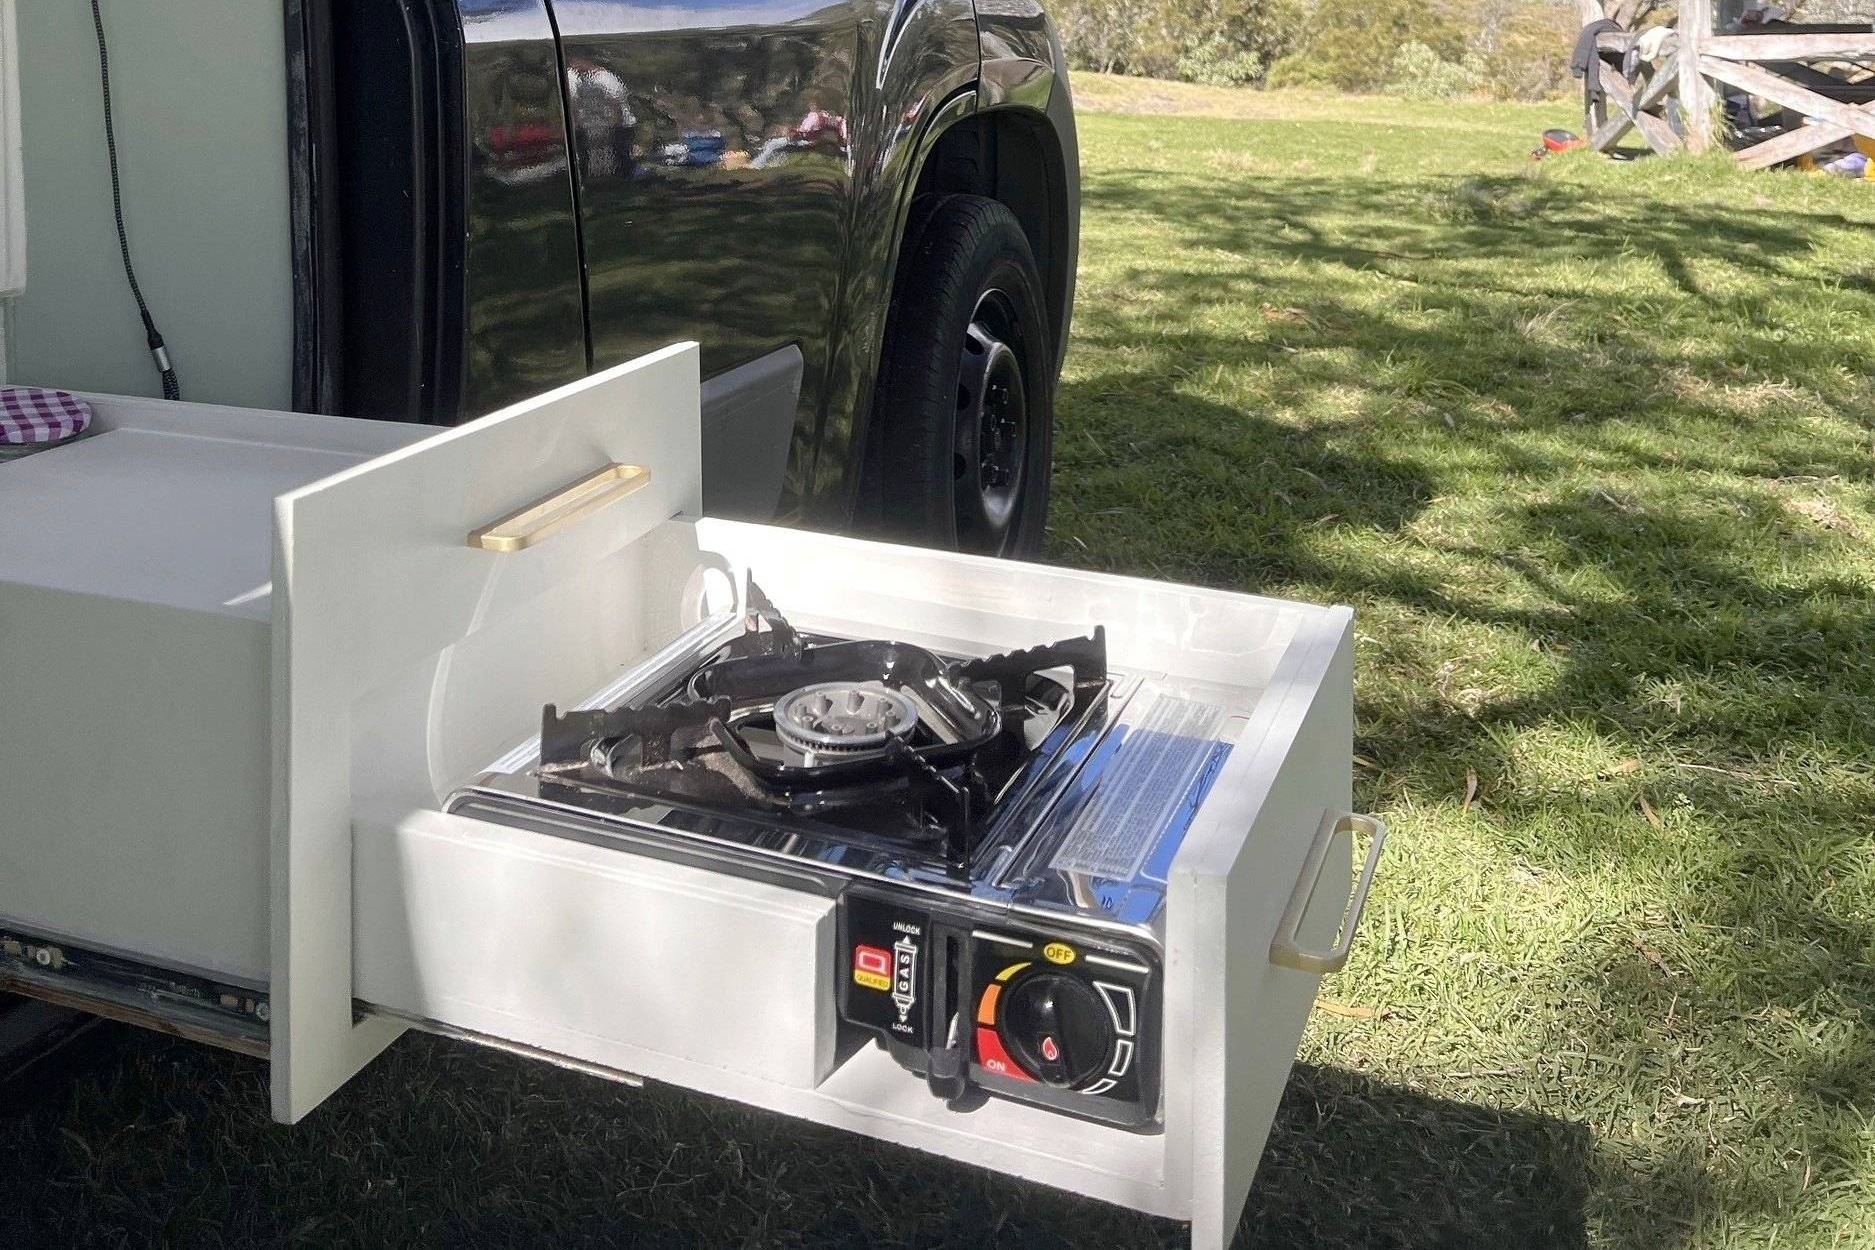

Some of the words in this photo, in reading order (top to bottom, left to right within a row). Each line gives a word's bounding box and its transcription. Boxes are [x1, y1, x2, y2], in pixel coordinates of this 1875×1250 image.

[893, 922, 921, 935] UNLOCK
[1046, 948, 1071, 961] OFF
[899, 954, 910, 992] GAS
[892, 1022, 913, 1034] LOCK
[986, 1060, 1006, 1071] ON
